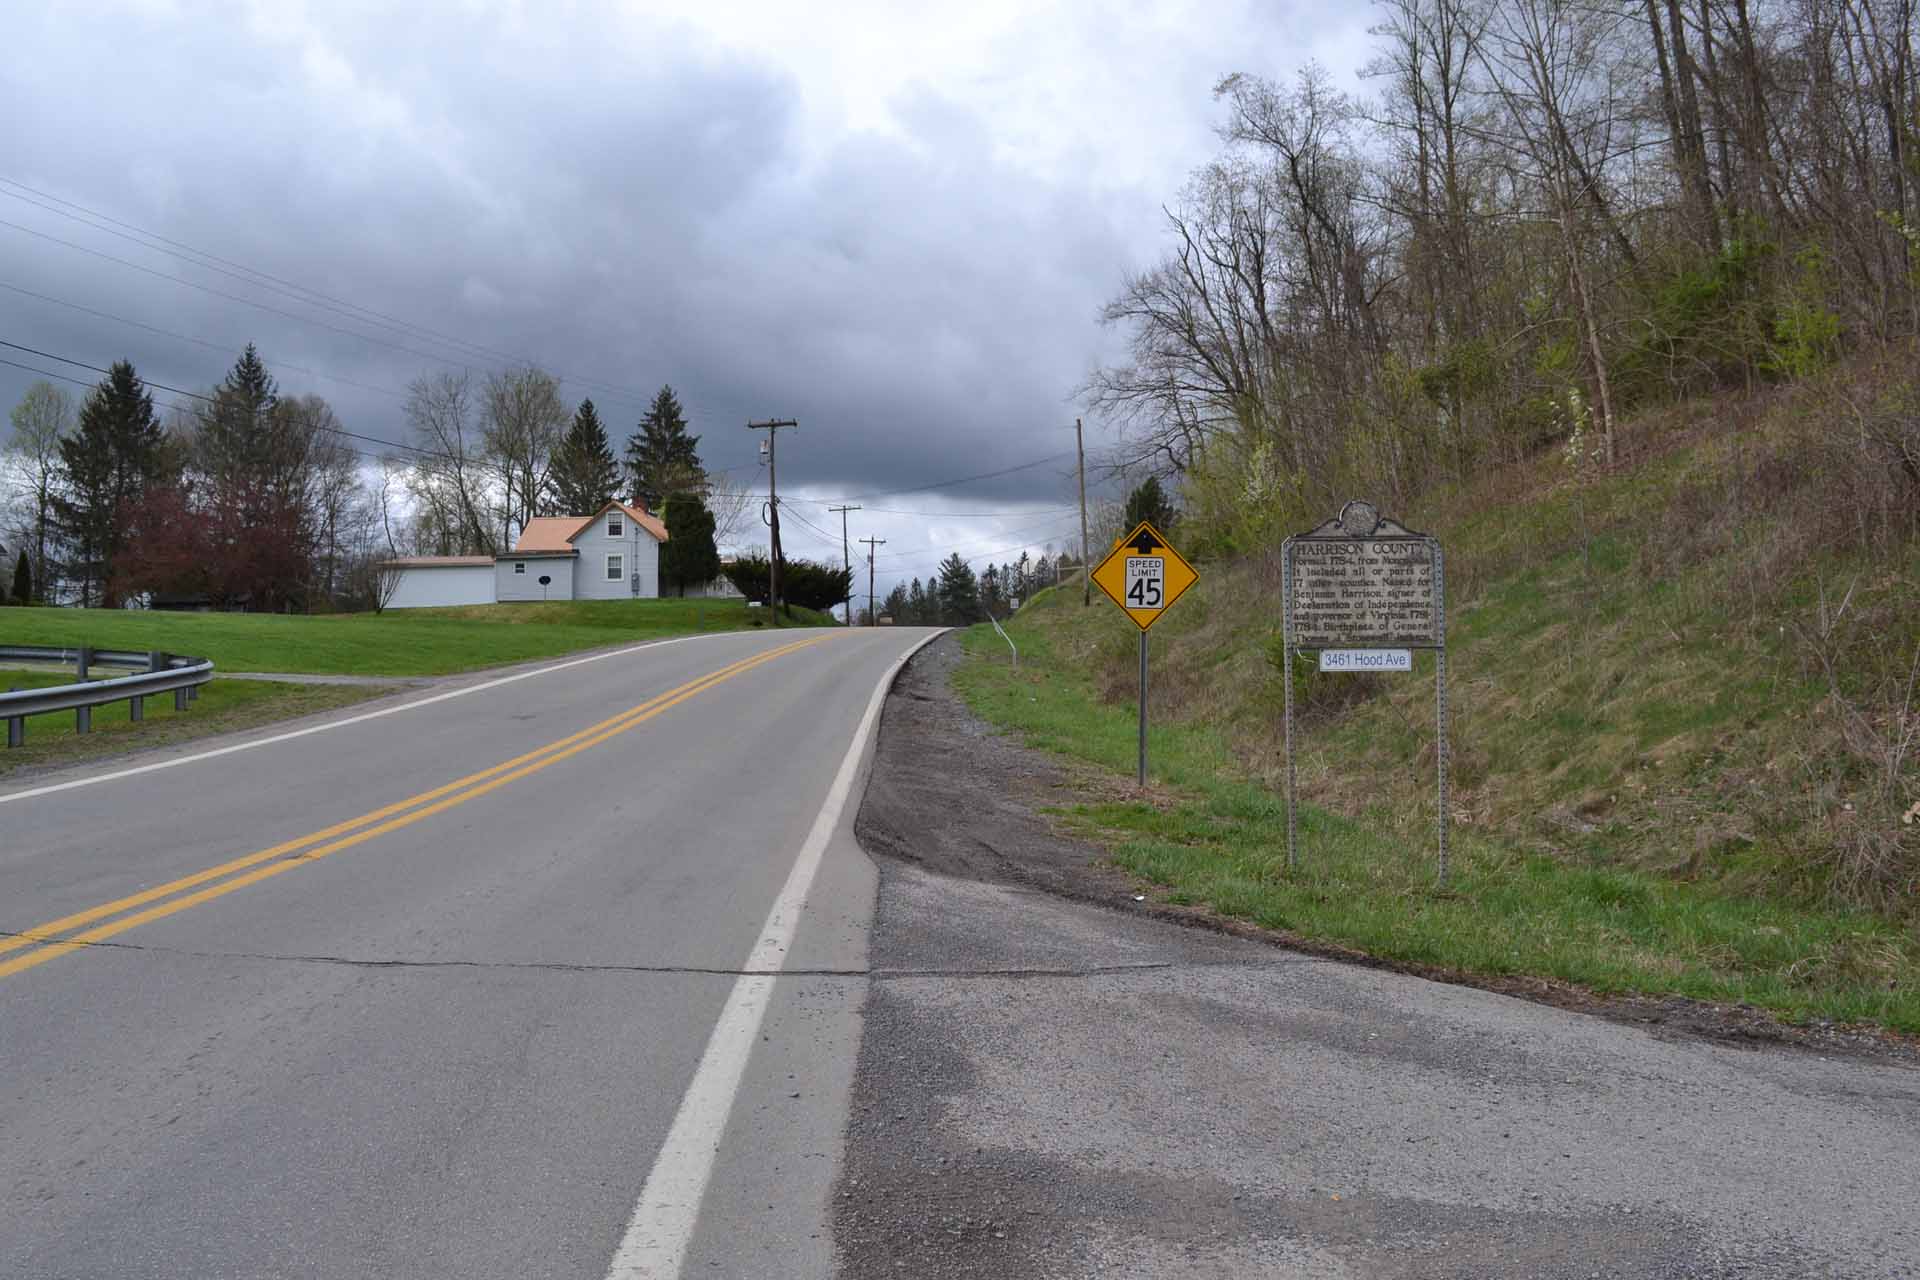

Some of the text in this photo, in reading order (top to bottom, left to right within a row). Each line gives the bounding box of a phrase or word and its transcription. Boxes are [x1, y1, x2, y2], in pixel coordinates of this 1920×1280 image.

[1296, 543, 1424, 555] HARRISON COUNTY
[1129, 560, 1161, 568] SPEED
[1307, 567, 1346, 577] included
[1352, 567, 1365, 577] all
[1389, 568, 1414, 576] parts
[1420, 567, 1431, 577] of
[1418, 578, 1431, 588] for
[1128, 578, 1161, 605] 45
[1422, 588, 1431, 597] of
[1294, 600, 1350, 609] Declaration
[1354, 600, 1364, 609] of
[1356, 611, 1367, 621] of
[1378, 622, 1388, 631] of
[1325, 653, 1406, 665] 3461 Hood Ave
